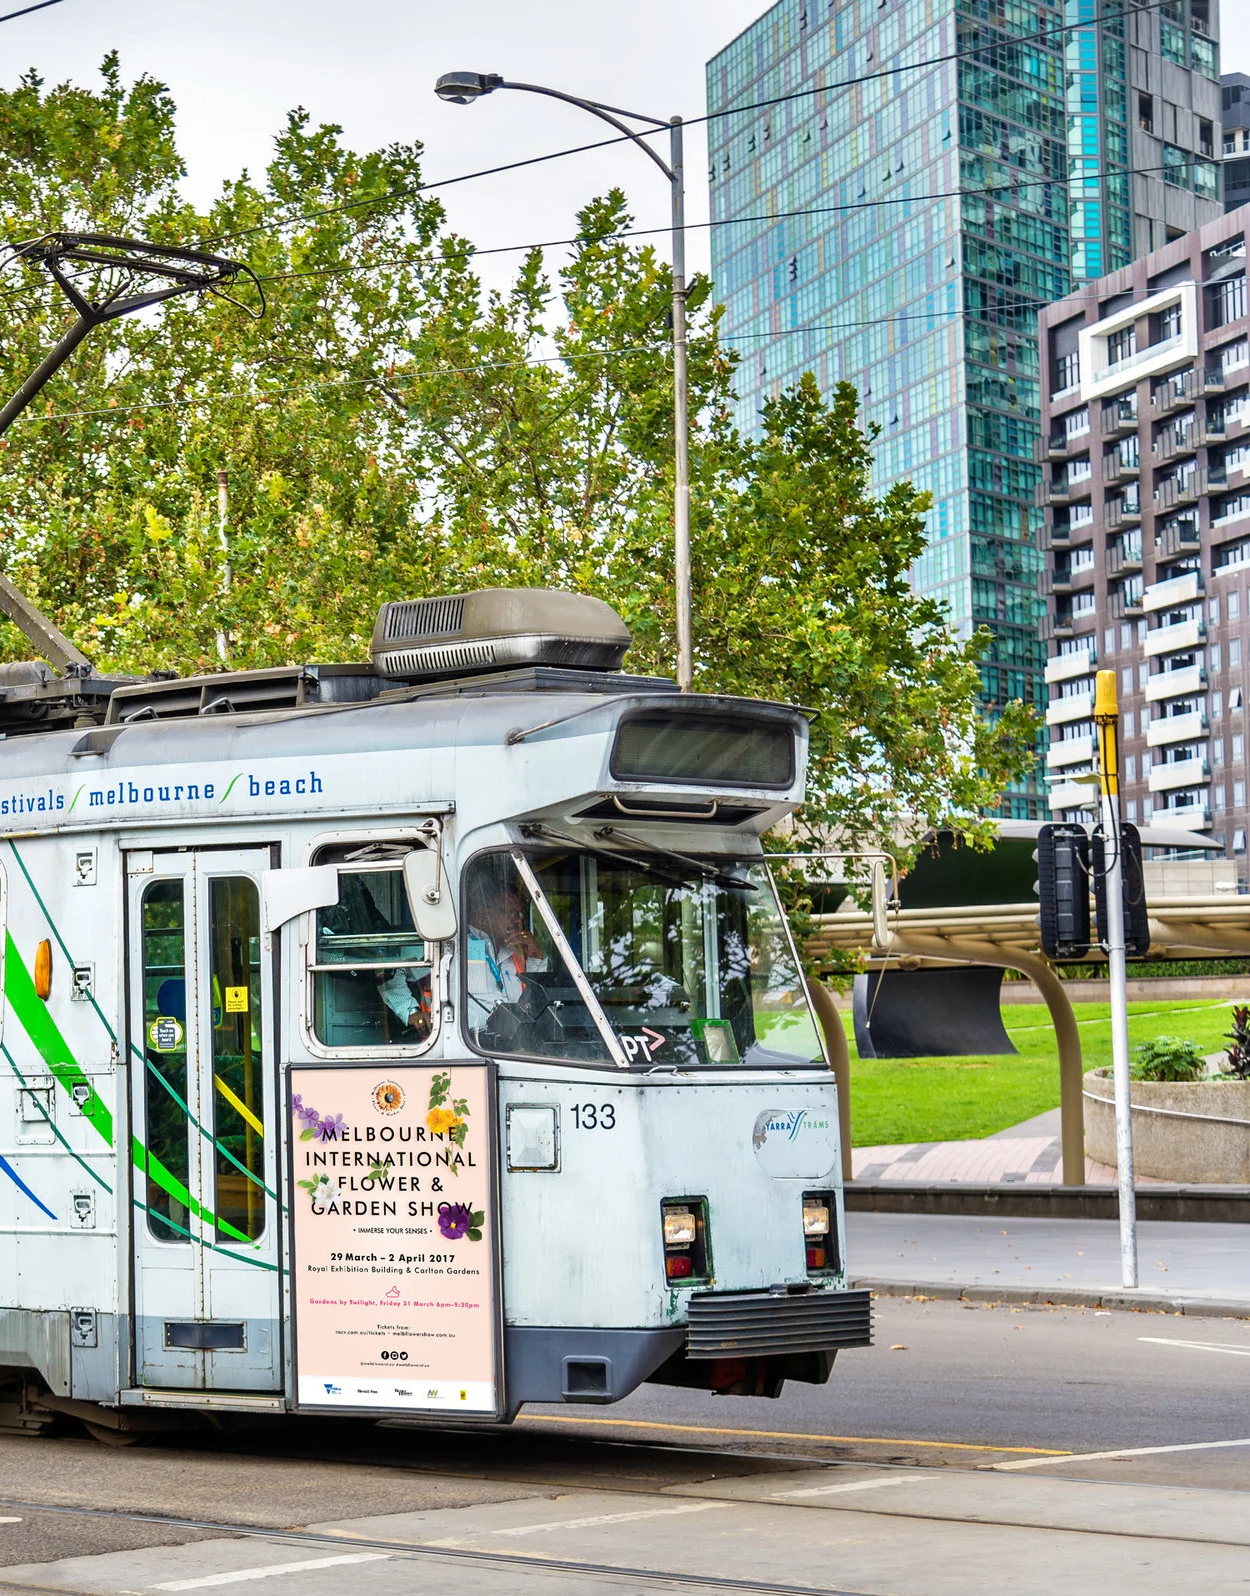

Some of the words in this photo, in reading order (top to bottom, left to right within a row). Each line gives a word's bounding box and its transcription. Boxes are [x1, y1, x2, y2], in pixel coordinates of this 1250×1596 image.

[89, 782, 215, 807] melbourne
[248, 771, 324, 797] beach
[570, 1103, 616, 1130] 133
[766, 1122, 792, 1131] YARRA
[803, 1120, 829, 1129] TRAMS
[321, 1126, 457, 1142] MELBOURNE
[306, 1151, 476, 1167] INTERNATIONAL
[338, 1176, 421, 1192] FLOWER
[431, 1176, 444, 1192] &
[311, 1201, 397, 1216] GARDEN
[408, 1201, 473, 1217] SHOW
[330, 1252, 343, 1261] 29
[345, 1252, 377, 1262] March
[388, 1253, 395, 1262] 2
[399, 1253, 425, 1264] April
[429, 1254, 456, 1263] 2017
[307, 1265, 328, 1273] Royal
[331, 1265, 368, 1273] Exhibition
[371, 1266, 403, 1274] Building
[406, 1266, 411, 1274] &
[447, 1267, 480, 1275] Gardens
